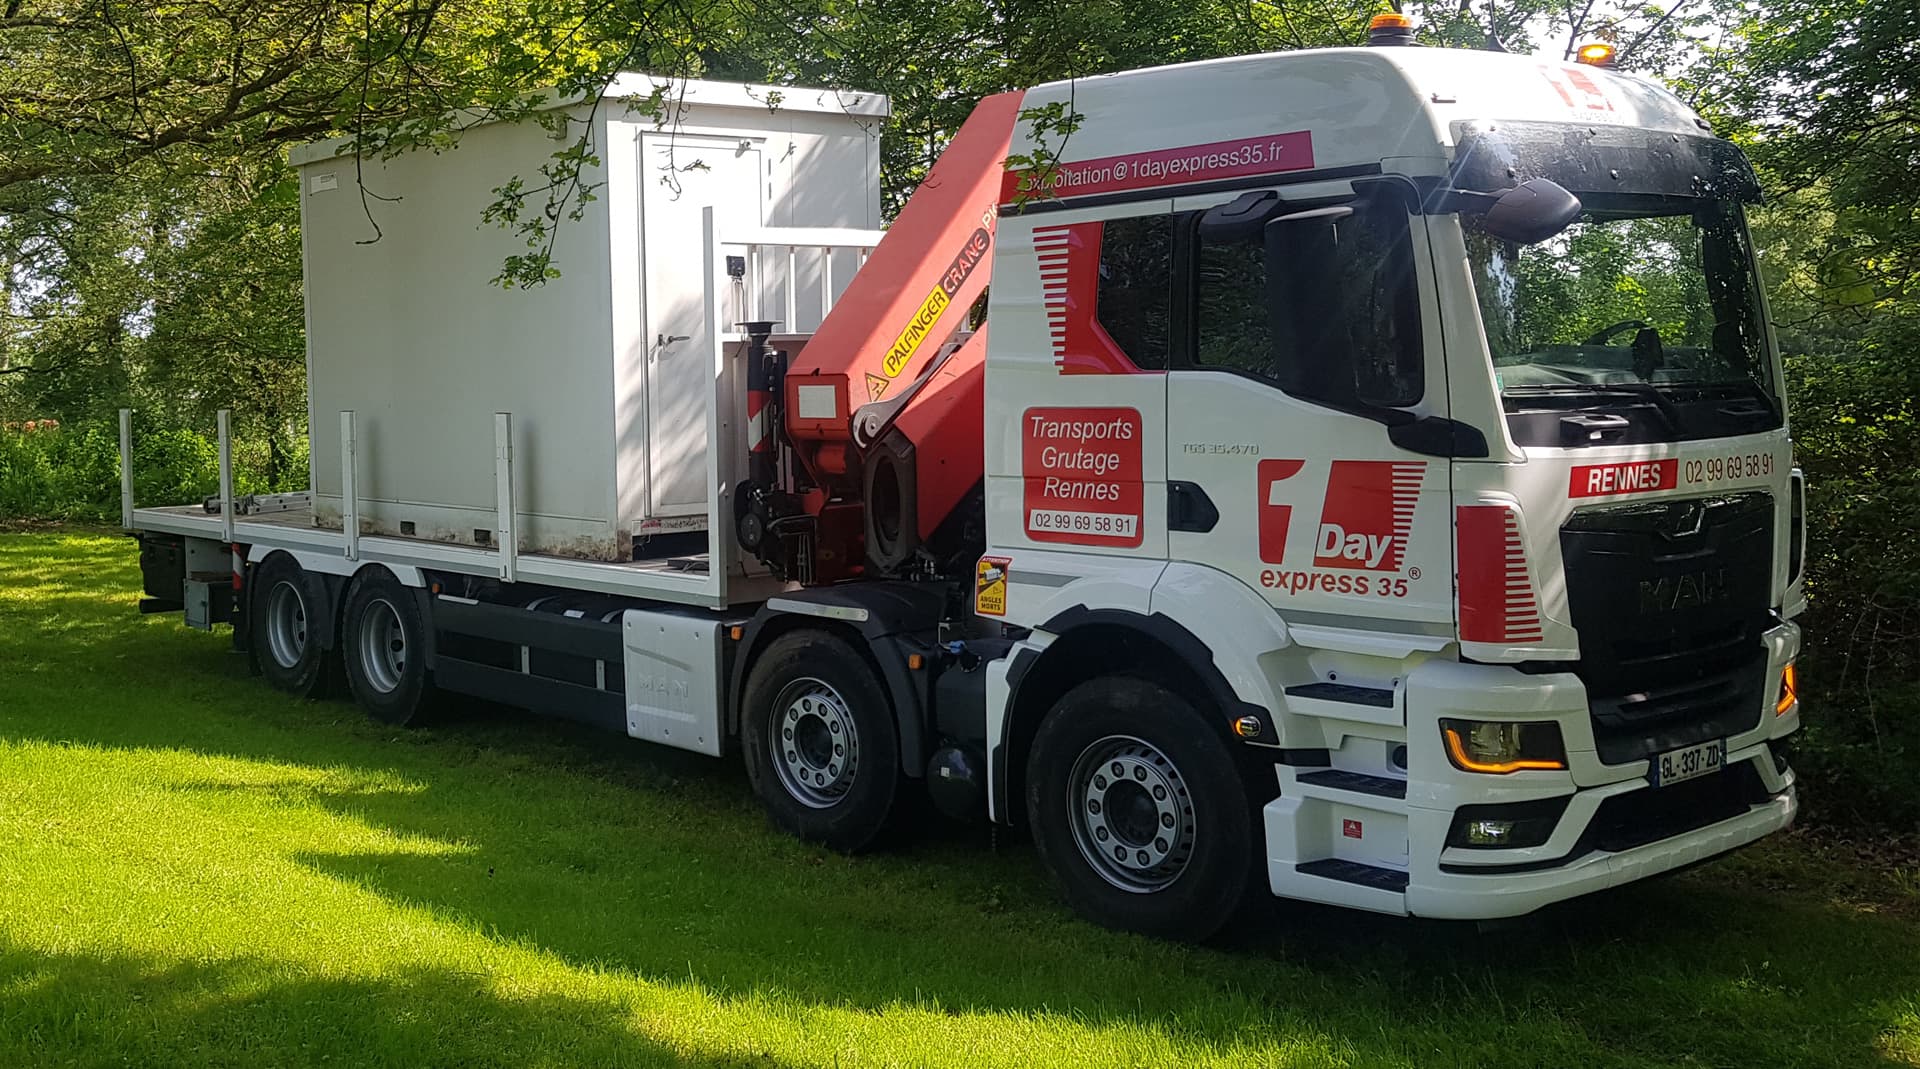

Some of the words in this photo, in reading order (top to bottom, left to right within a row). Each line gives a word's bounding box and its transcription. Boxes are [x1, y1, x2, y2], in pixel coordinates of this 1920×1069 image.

[886, 290, 946, 373] PALFINGER
[943, 233, 987, 294] CRANE
[1031, 416, 1133, 444] Transports
[1041, 446, 1120, 475] Grutage
[1587, 463, 1662, 494] RENNES
[1685, 460, 1703, 484] 02
[1706, 458, 1723, 481] 99
[1726, 455, 1742, 479] 69
[1746, 453, 1760, 477] 58
[1762, 451, 1775, 475] 91
[1043, 476, 1120, 501] Rennes
[1035, 512, 1051, 528] 02
[1054, 514, 1071, 529] 99
[1074, 515, 1091, 531] 69
[1095, 516, 1111, 532] 58
[1115, 517, 1131, 533] 91
[1315, 523, 1393, 569] Day
[1259, 569, 1370, 596] express
[1376, 578, 1409, 598] 35
[979, 595, 1002, 604] ANGLES
[980, 603, 1002, 611] MORTS
